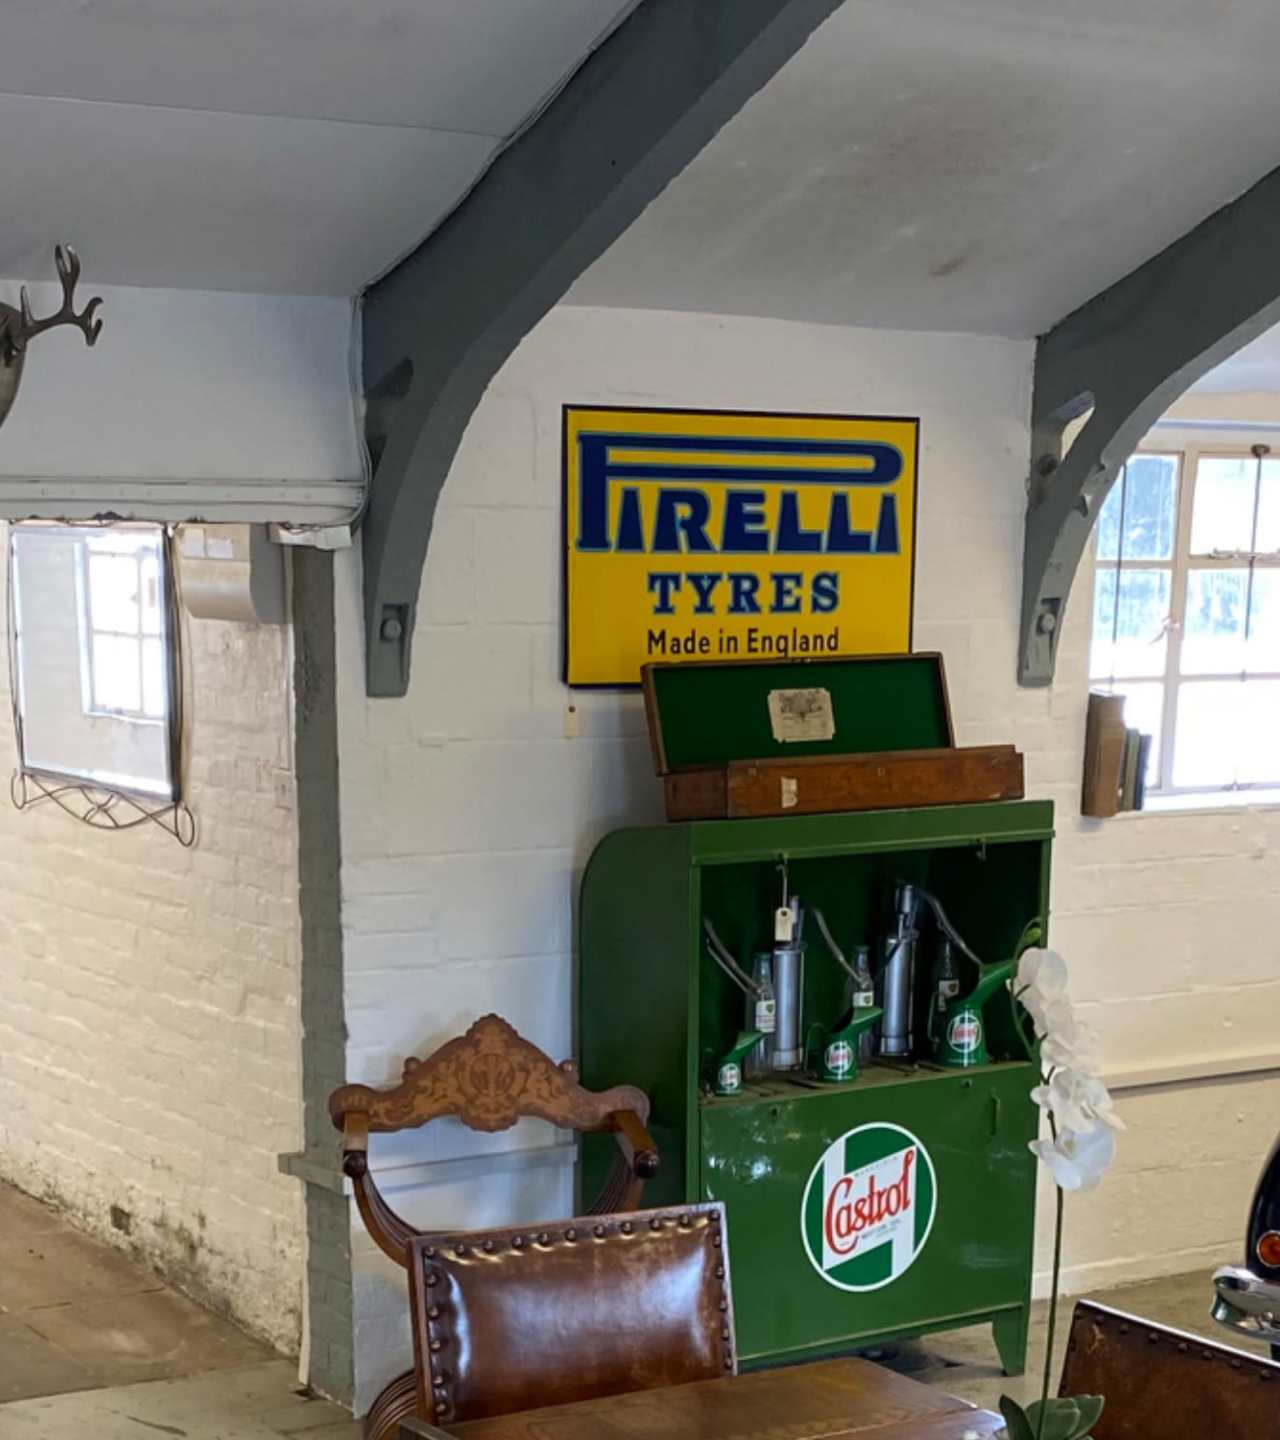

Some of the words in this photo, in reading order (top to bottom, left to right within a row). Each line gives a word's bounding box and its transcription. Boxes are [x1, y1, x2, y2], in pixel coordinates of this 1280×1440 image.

[575, 430, 904, 555] PIRELLI
[647, 571, 840, 615] TYRES
[647, 628, 711, 655] Made
[718, 627, 739, 654] in
[747, 626, 840, 658] England
[825, 1149, 915, 1255] Castrol
